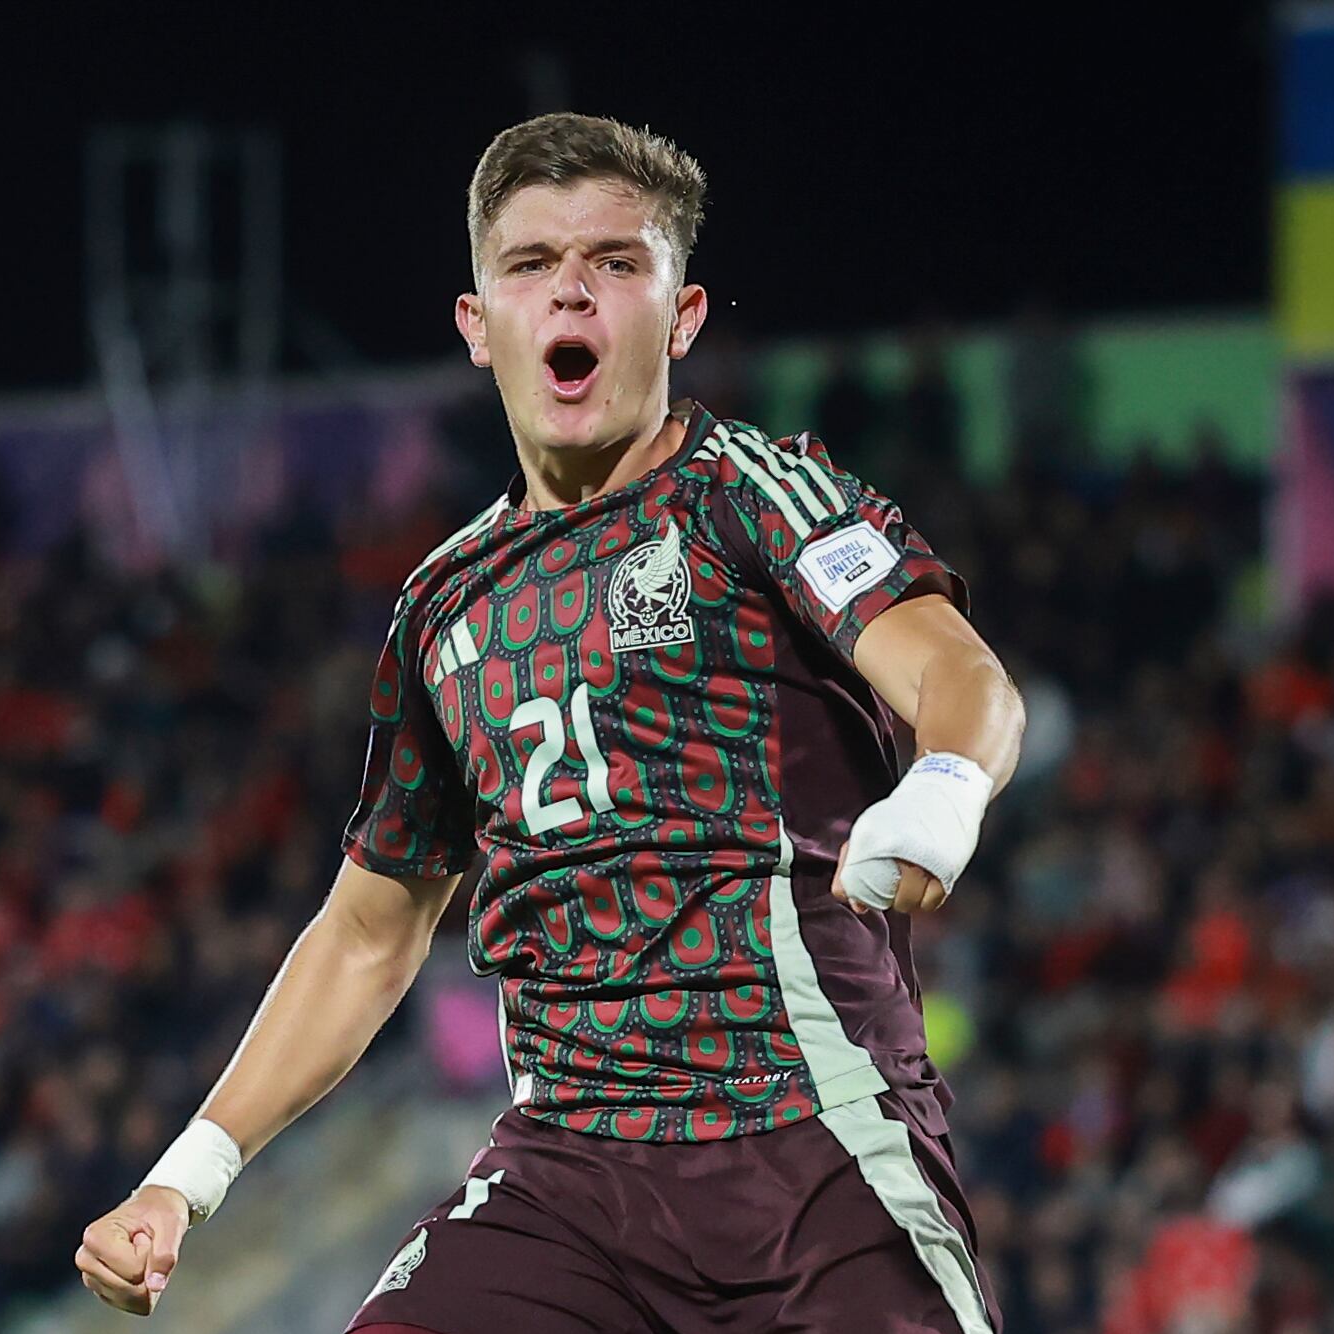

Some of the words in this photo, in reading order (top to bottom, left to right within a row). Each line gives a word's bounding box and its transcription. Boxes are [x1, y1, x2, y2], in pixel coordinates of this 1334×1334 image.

[816, 540, 864, 568] FOOTBALL
[613, 623, 689, 648] MÉXICO
[509, 681, 616, 836] 21
